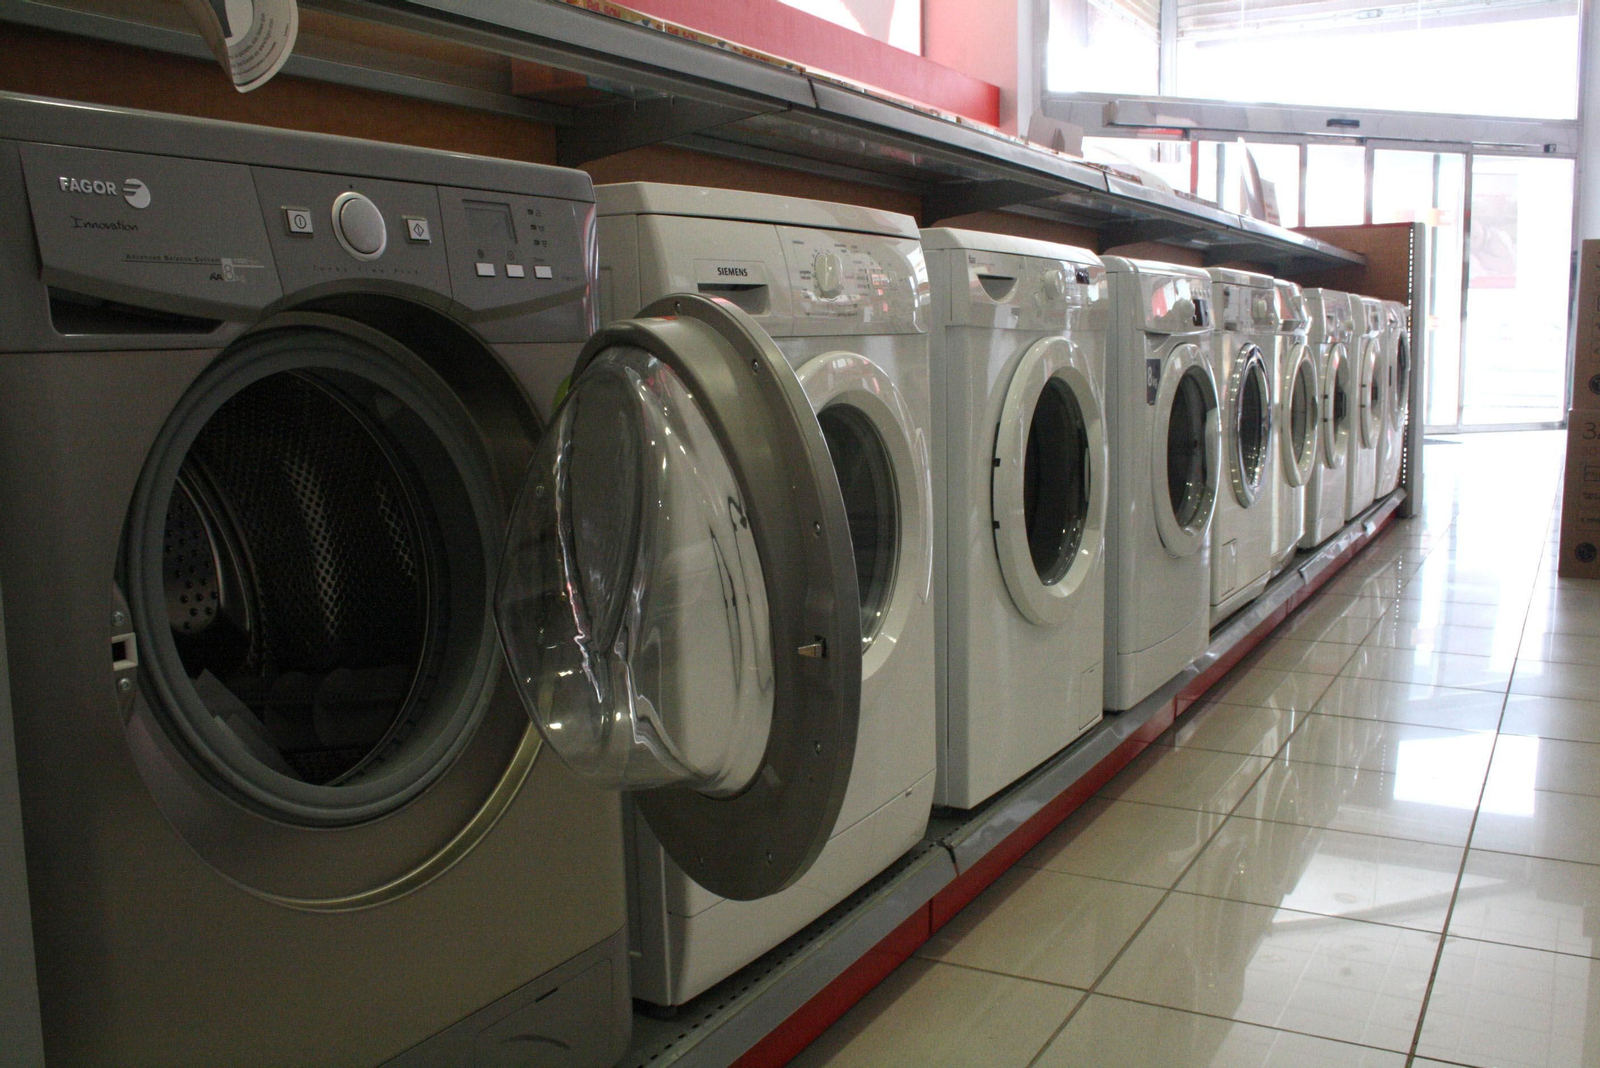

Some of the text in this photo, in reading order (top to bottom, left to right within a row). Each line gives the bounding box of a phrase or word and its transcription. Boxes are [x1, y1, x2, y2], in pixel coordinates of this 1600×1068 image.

[59, 176, 117, 196] FAGOR
[70, 215, 139, 232] Innovation
[717, 267, 748, 277] SIEMENS
[1147, 366, 1153, 387] 8
